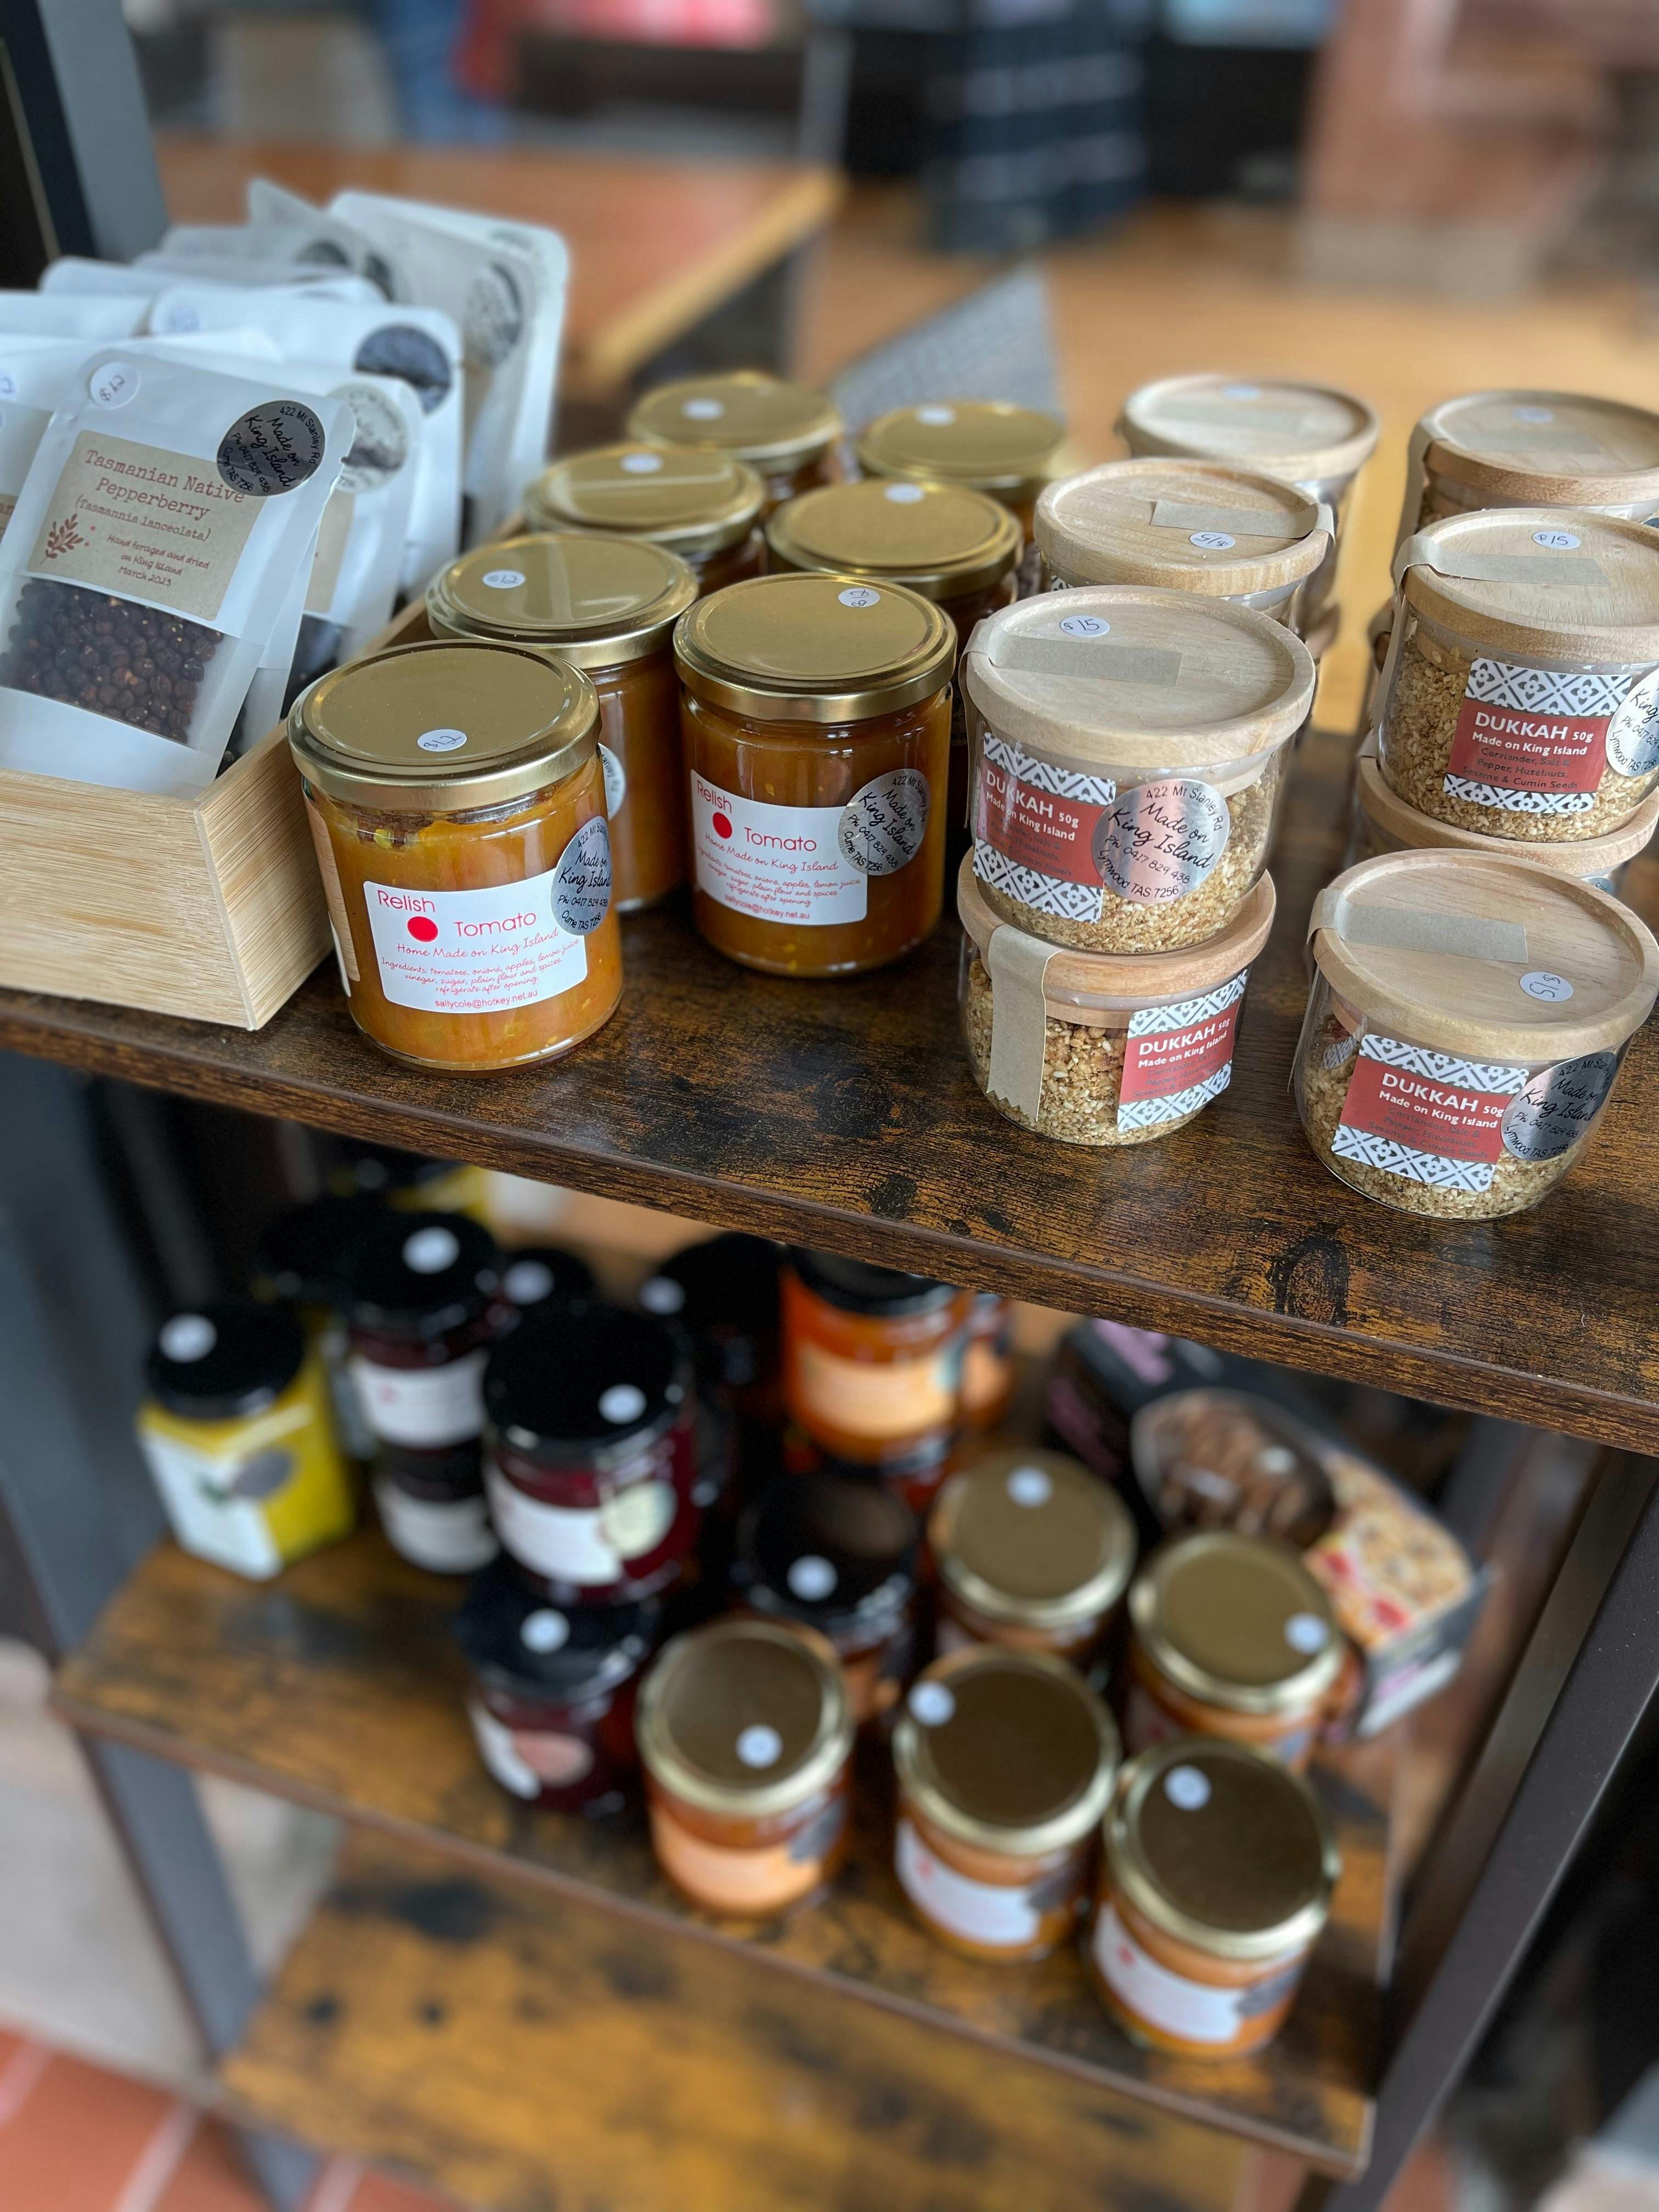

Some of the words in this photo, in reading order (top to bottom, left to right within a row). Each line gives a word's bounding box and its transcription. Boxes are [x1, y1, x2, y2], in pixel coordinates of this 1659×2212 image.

[279, 406, 296, 416] 422
[267, 417, 294, 451] Made
[287, 452, 300, 466] on
[305, 418, 321, 450] Stanley
[245, 415, 268, 448] King
[262, 446, 297, 487] Island
[309, 452, 320, 465] Rd
[85, 449, 179, 488] Tasmanian
[182, 475, 245, 503] Native
[226, 467, 239, 482] TAS
[249, 461, 262, 476] 829
[258, 477, 271, 492] 438
[95, 477, 211, 521] Pepperberry
[75, 495, 138, 523] (Tasmannia
[140, 516, 212, 542] lanceolata)
[1534, 534, 1568, 545] $15
[107, 534, 131, 548] Hand
[132, 541, 166, 557] foraged
[166, 551, 185, 562] and
[185, 555, 210, 570] dried
[118, 566, 148, 581] March
[148, 574, 172, 587] 2023
[133, 556, 154, 570] King
[155, 561, 184, 576] Island
[1629, 688, 1658, 724] King
[1475, 712, 1568, 740] DUKKAH
[1572, 731, 1594, 743] 50g
[1632, 725, 1649, 738] 0417
[424, 736, 462, 749] $12
[1472, 731, 1502, 747] Made
[1505, 742, 1520, 751] on
[1522, 743, 1550, 757] King
[1553, 746, 1588, 755] Island
[1477, 758, 1511, 773] Pepper,
[1626, 757, 1641, 772] TAS
[893, 776, 906, 786] 422
[907, 776, 915, 787] Mt
[1502, 775, 1509, 783] &
[1513, 777, 1547, 788] Cumin
[1550, 781, 1578, 789] Seeds
[697, 780, 732, 813] Relish
[986, 770, 1053, 819] DUKKAH
[1058, 812, 1079, 828] 50g
[882, 789, 908, 819] Made
[905, 818, 916, 831] on
[986, 791, 1006, 811] Made
[1007, 808, 1017, 820] on
[1019, 813, 1040, 833] King
[1043, 823, 1075, 842] Island
[1147, 786, 1167, 798] 422
[1172, 786, 1187, 796] Mt
[1189, 788, 1220, 816] Stanley
[1213, 816, 1223, 831] Rd
[859, 792, 885, 827] King
[883, 819, 917, 855] Island
[1140, 803, 1188, 833] Made
[1189, 830, 1208, 843] on
[578, 832, 589, 848] 422
[590, 826, 596, 836] Mt
[744, 827, 817, 851] Tomato
[859, 827, 876, 842] 0417
[873, 842, 887, 855] 829
[885, 854, 899, 868] 438
[1108, 808, 1154, 847] King
[1154, 834, 1214, 869] Island
[575, 850, 599, 867] Made
[600, 859, 607, 867] on
[706, 833, 725, 851] Home
[727, 845, 753, 862] Made
[755, 857, 768, 866] on
[772, 858, 798, 874] King
[801, 861, 838, 871] Island
[853, 851, 867, 866] TAS
[865, 860, 883, 871] 7256
[1124, 847, 1149, 864] 0417
[1149, 861, 1170, 874] 829
[1171, 871, 1191, 884] 438
[558, 867, 588, 893] King
[753, 882, 774, 892] plain
[774, 887, 792, 896] flour
[814, 880, 838, 888] lemon
[1131, 883, 1151, 897] TAS
[1154, 885, 1179, 898] 7256
[377, 890, 436, 913] Relish
[571, 897, 587, 906] 0417
[588, 898, 599, 907] 829
[760, 893, 777, 902] after
[780, 898, 812, 907] opening
[454, 913, 537, 936] Tomato
[578, 920, 589, 930] TAS
[397, 943, 430, 956] Home
[433, 948, 468, 958] Made
[492, 944, 521, 955] King
[523, 927, 558, 949] Island
[505, 958, 535, 972] apples,
[538, 950, 561, 961] lemon
[436, 986, 480, 996] refrigerate
[482, 984, 501, 994] after
[504, 977, 538, 991] opening
[471, 975, 495, 986] plain
[497, 972, 518, 984] flour
[520, 966, 537, 976] and
[435, 990, 538, 1009] sallycole@hotkey.net.au
[1139, 1023, 1216, 1056] DUKKAH
[1217, 1018, 1231, 1031] 50g
[1138, 1058, 1166, 1069] Made
[1169, 1054, 1182, 1063] on
[1184, 1045, 1205, 1058] King
[1206, 1030, 1227, 1049] Island
[1559, 1064, 1578, 1076] 422
[1582, 1061, 1592, 1069] Mt
[1382, 1073, 1479, 1112] DUKKAH
[1482, 1105, 1505, 1118] 50g
[1551, 1078, 1587, 1099] Made
[1586, 1093, 1598, 1101] on
[1379, 1090, 1410, 1108] Made
[1414, 1105, 1427, 1114] on
[1431, 1109, 1459, 1125] King
[1462, 1116, 1498, 1128] Island
[1520, 1088, 1558, 1118] King
[1558, 1102, 1598, 1121] Island
[1530, 1119, 1549, 1130] 0417
[1549, 1125, 1564, 1135] 829
[1530, 1147, 1548, 1158] TAS
